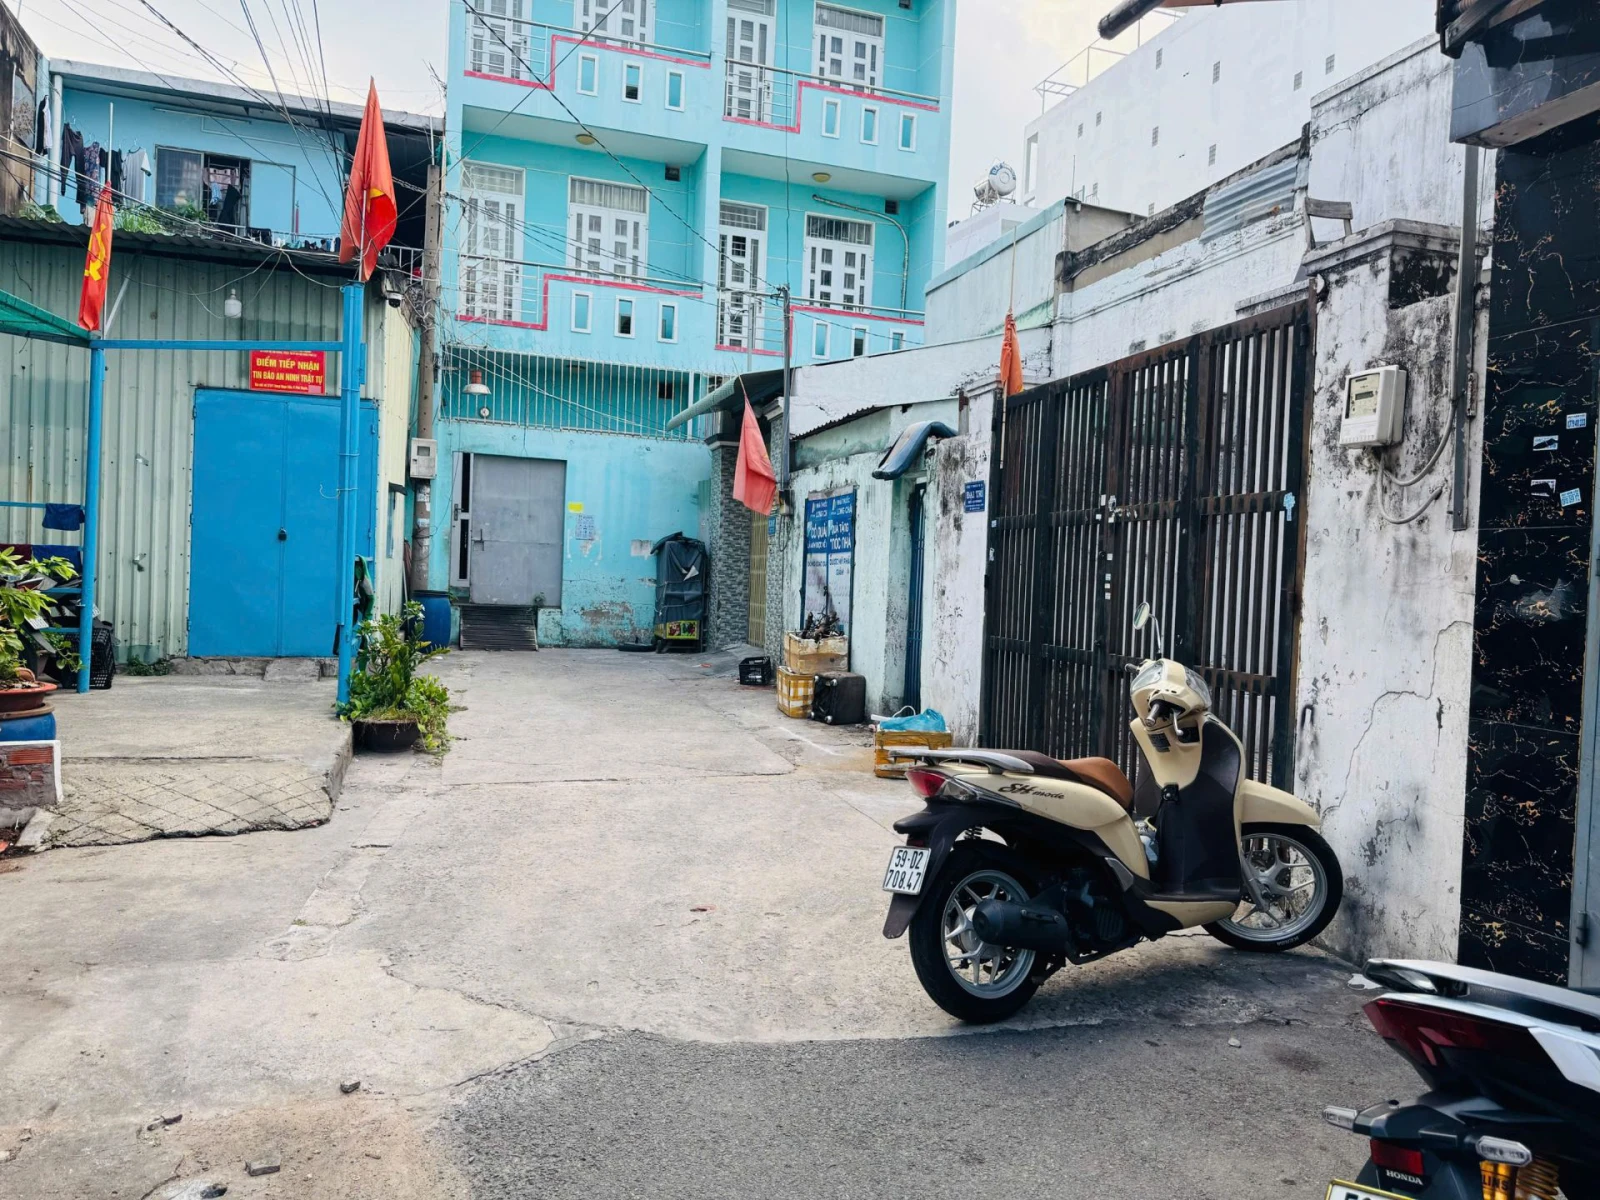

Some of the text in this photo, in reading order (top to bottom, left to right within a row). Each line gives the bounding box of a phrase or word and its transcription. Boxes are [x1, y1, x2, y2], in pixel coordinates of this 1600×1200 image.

[279, 358, 296, 369] TIẾP
[298, 361, 320, 373] NHẬN
[253, 371, 262, 379] TIN
[263, 370, 275, 380] BÁO
[276, 373, 285, 381] AN
[286, 373, 300, 382] NINH
[301, 374, 314, 384] TRẬT
[895, 849, 924, 869] 59-D2
[885, 869, 922, 891] 708.47
[1385, 1169, 1423, 1186] HONDA
